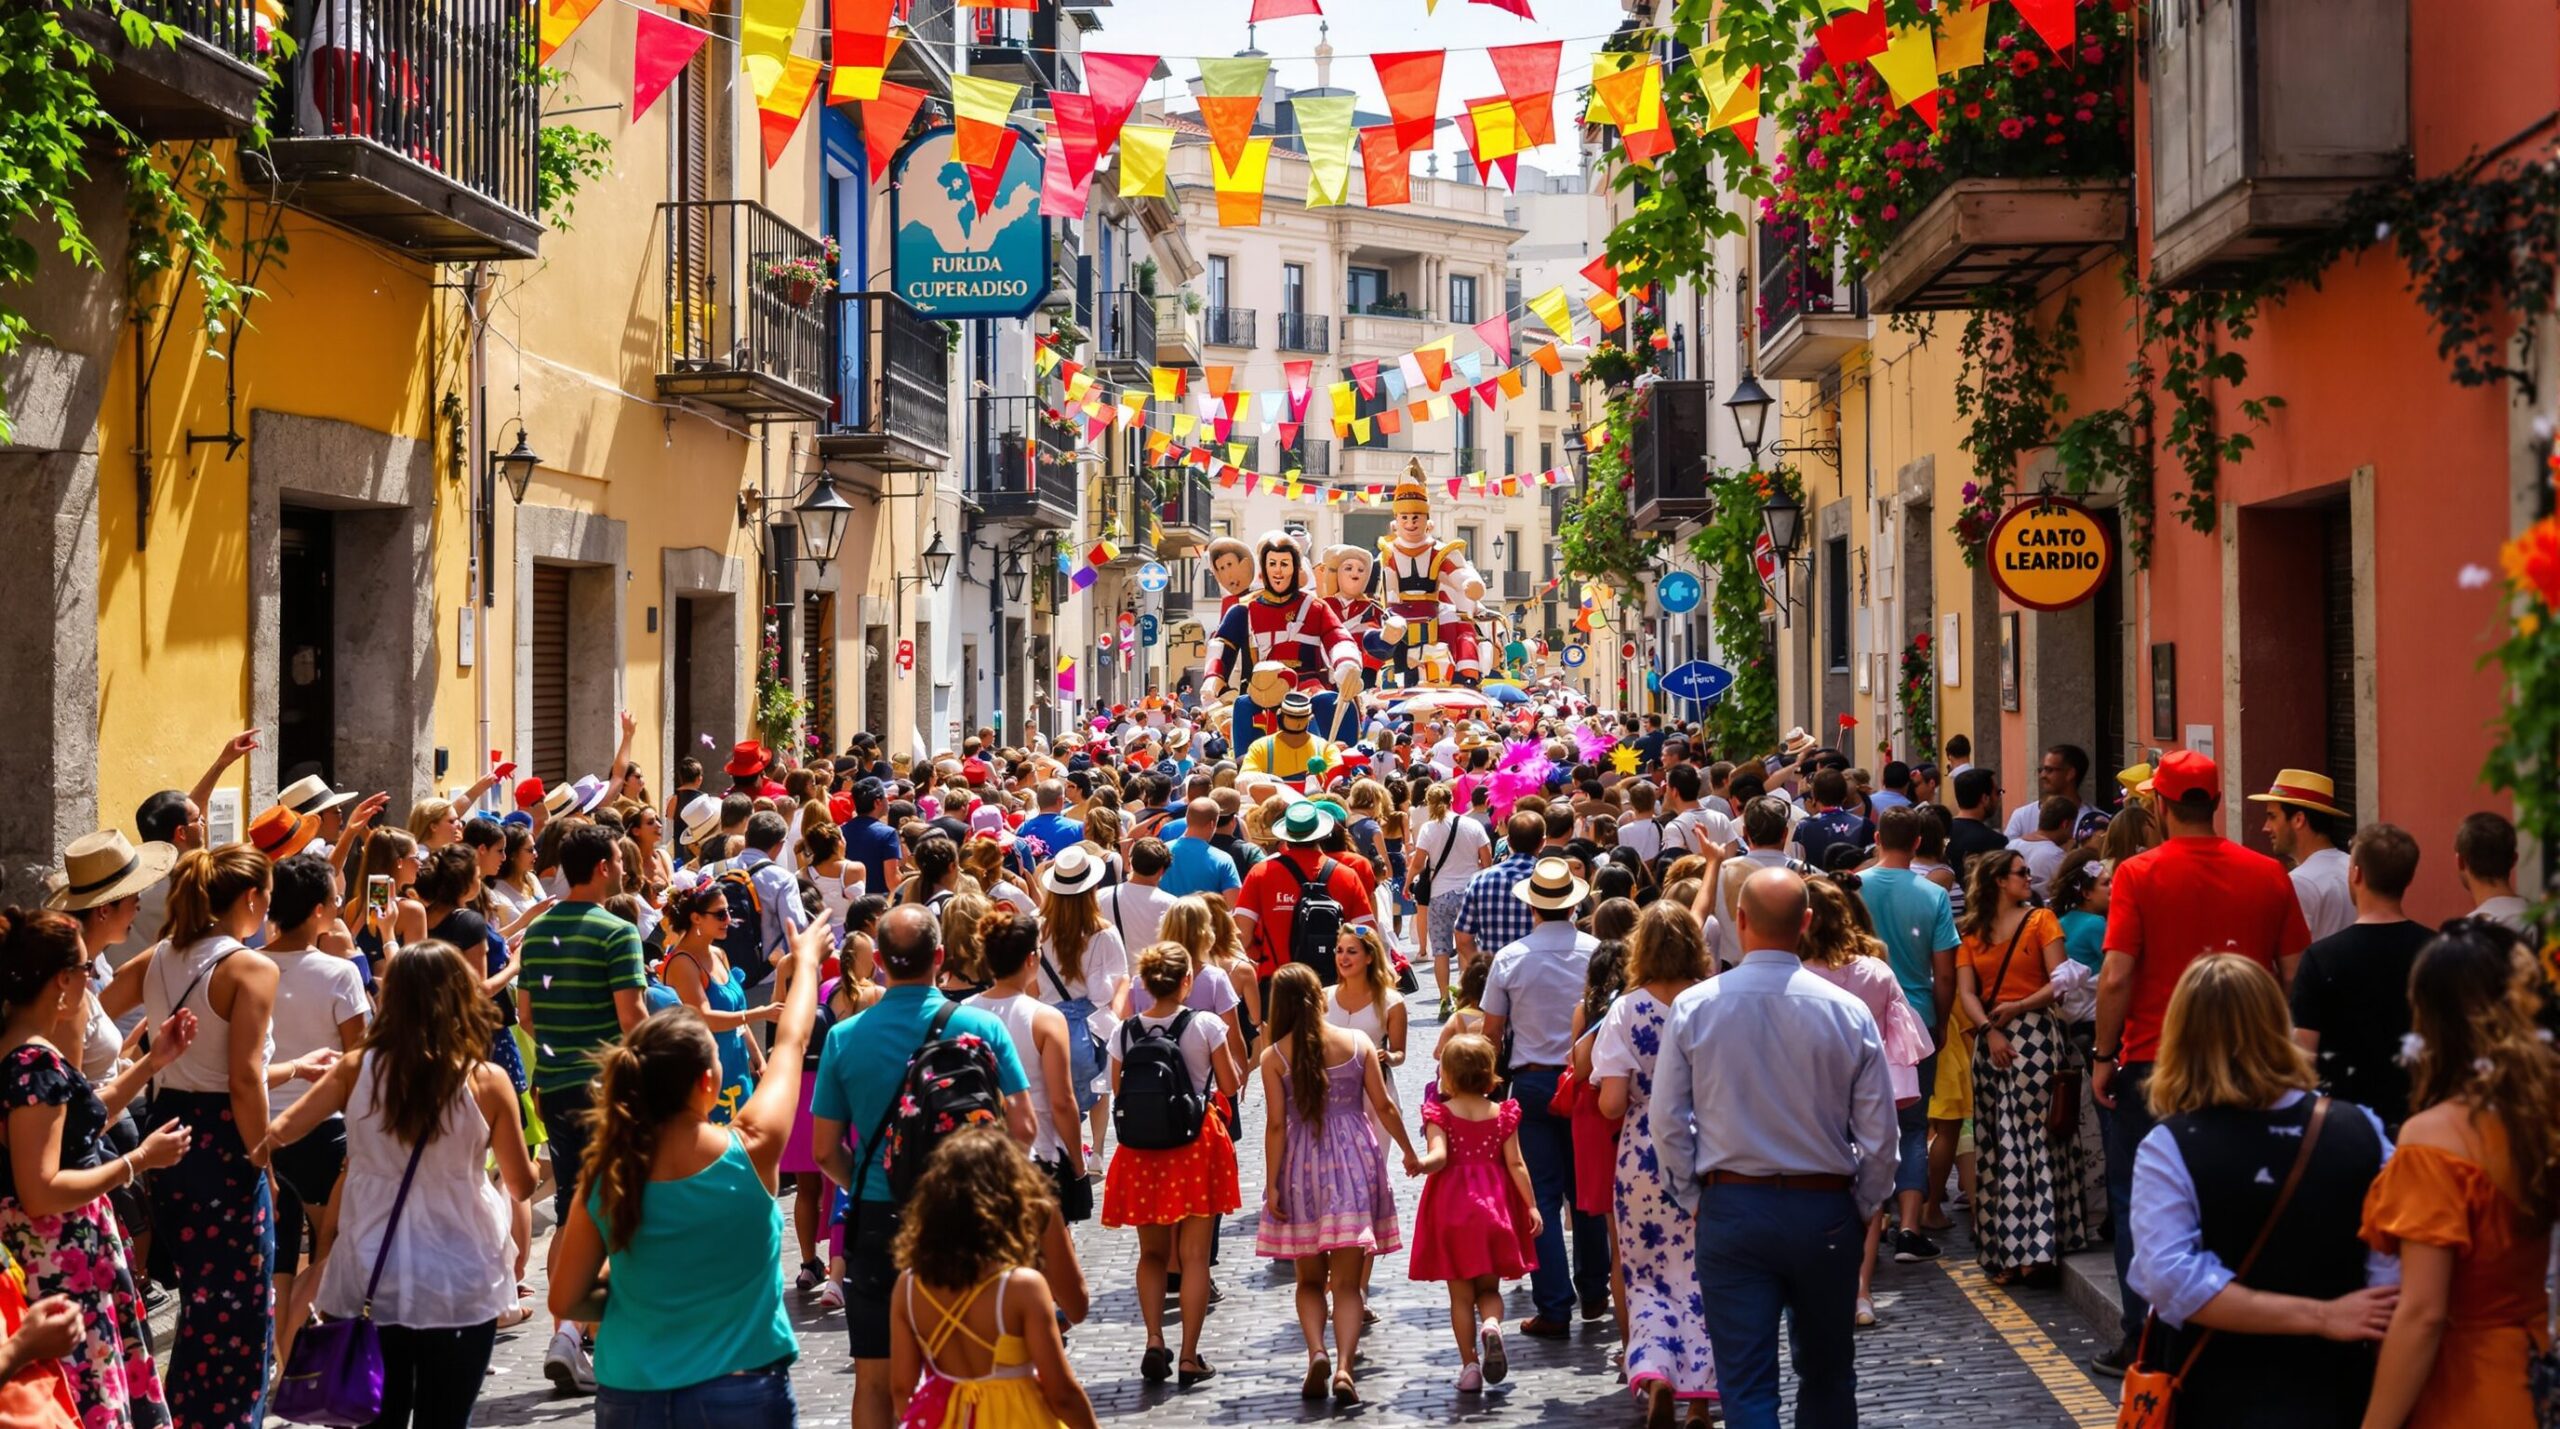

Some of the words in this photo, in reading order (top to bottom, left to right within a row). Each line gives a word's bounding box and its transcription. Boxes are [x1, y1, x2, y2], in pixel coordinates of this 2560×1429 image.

[932, 256, 1003, 273] FURLDA
[909, 280, 1028, 298] CUPERADISO
[2005, 552, 2099, 570] LEARDIO
